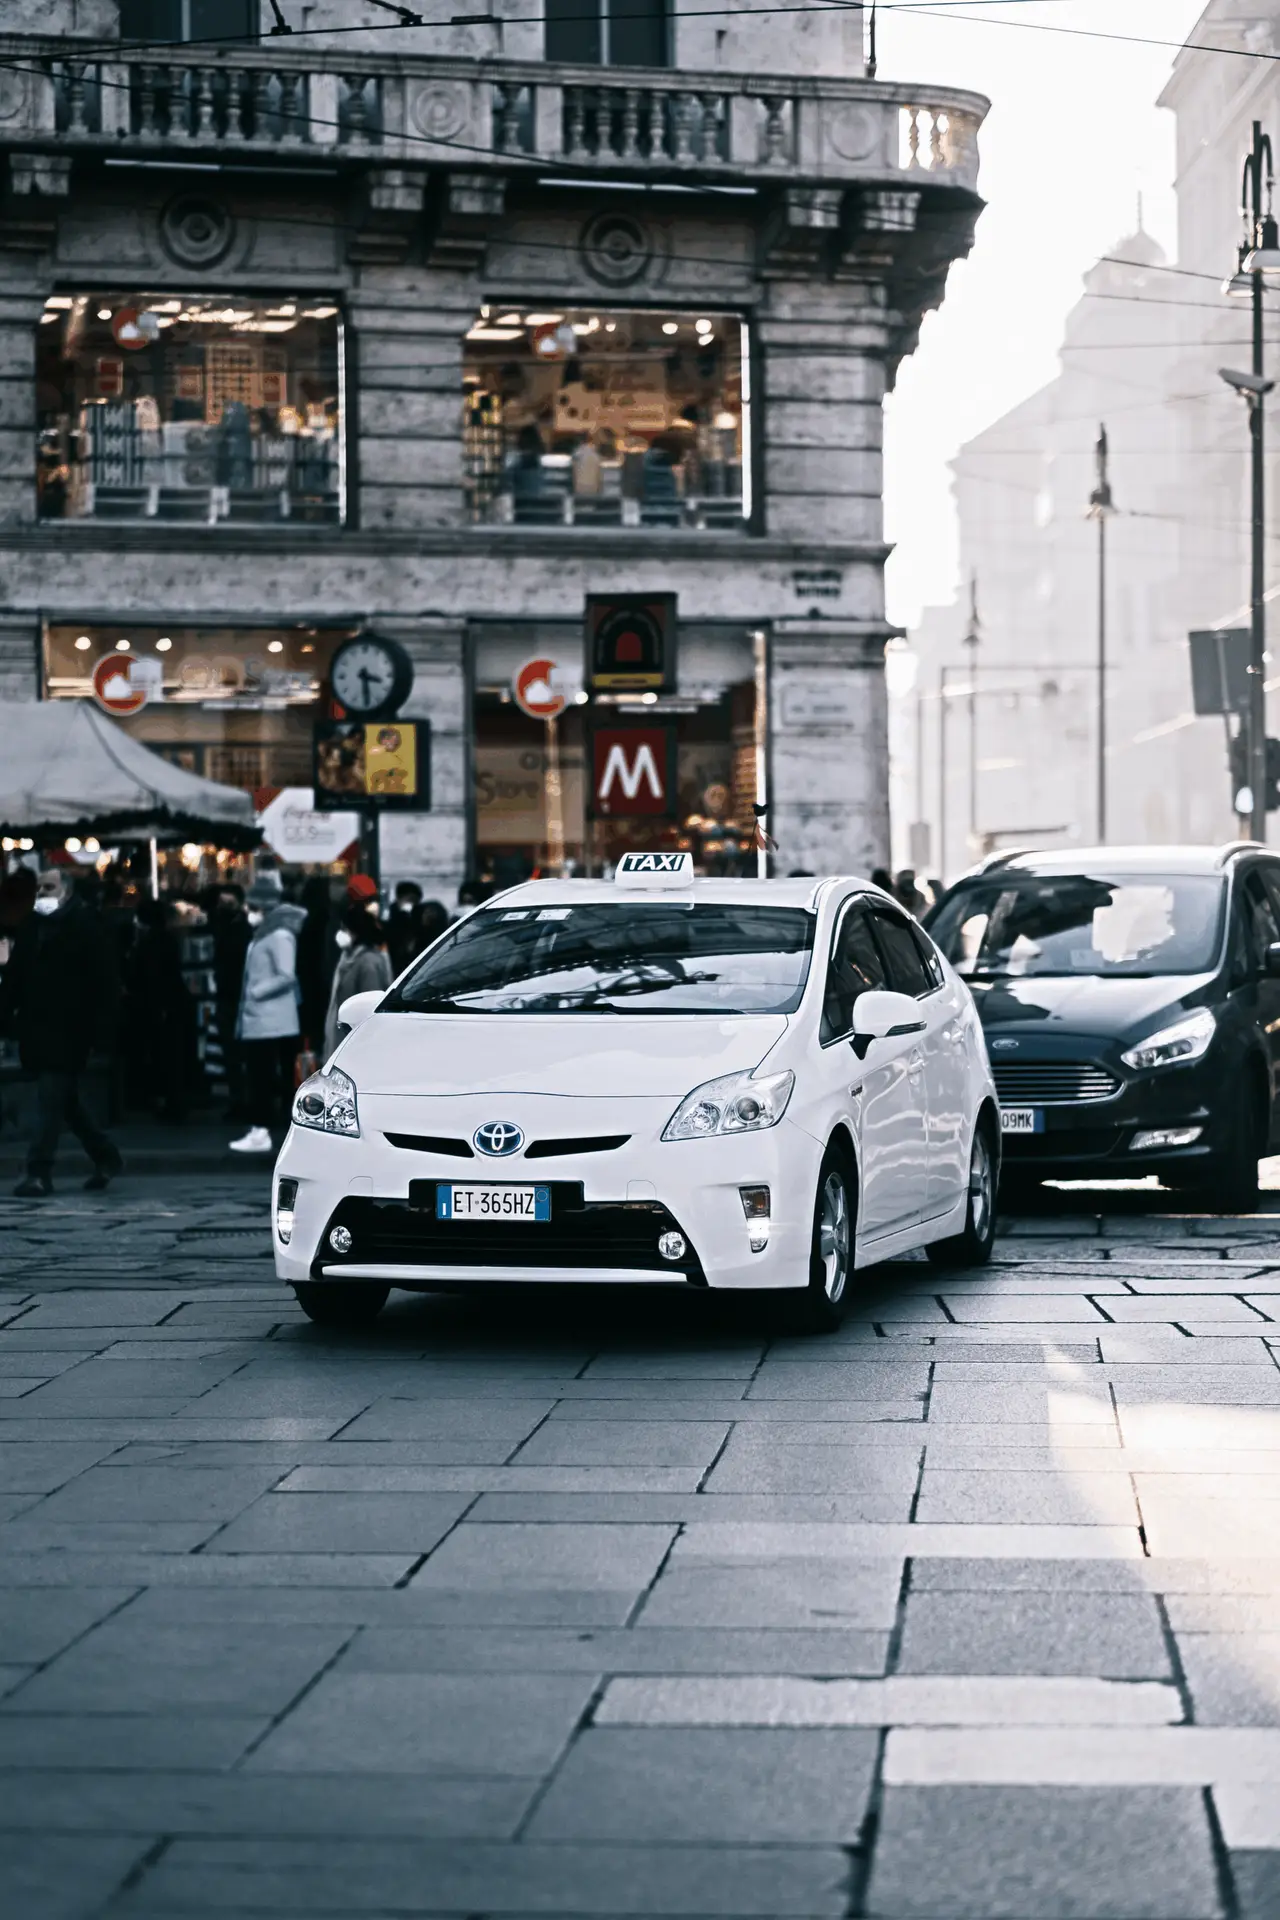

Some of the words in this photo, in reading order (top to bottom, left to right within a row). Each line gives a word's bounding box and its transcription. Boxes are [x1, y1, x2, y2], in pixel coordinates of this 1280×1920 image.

[599, 744, 663, 798] M
[628, 855, 683, 871] TAXI
[1002, 1113, 1032, 1128] 09MK
